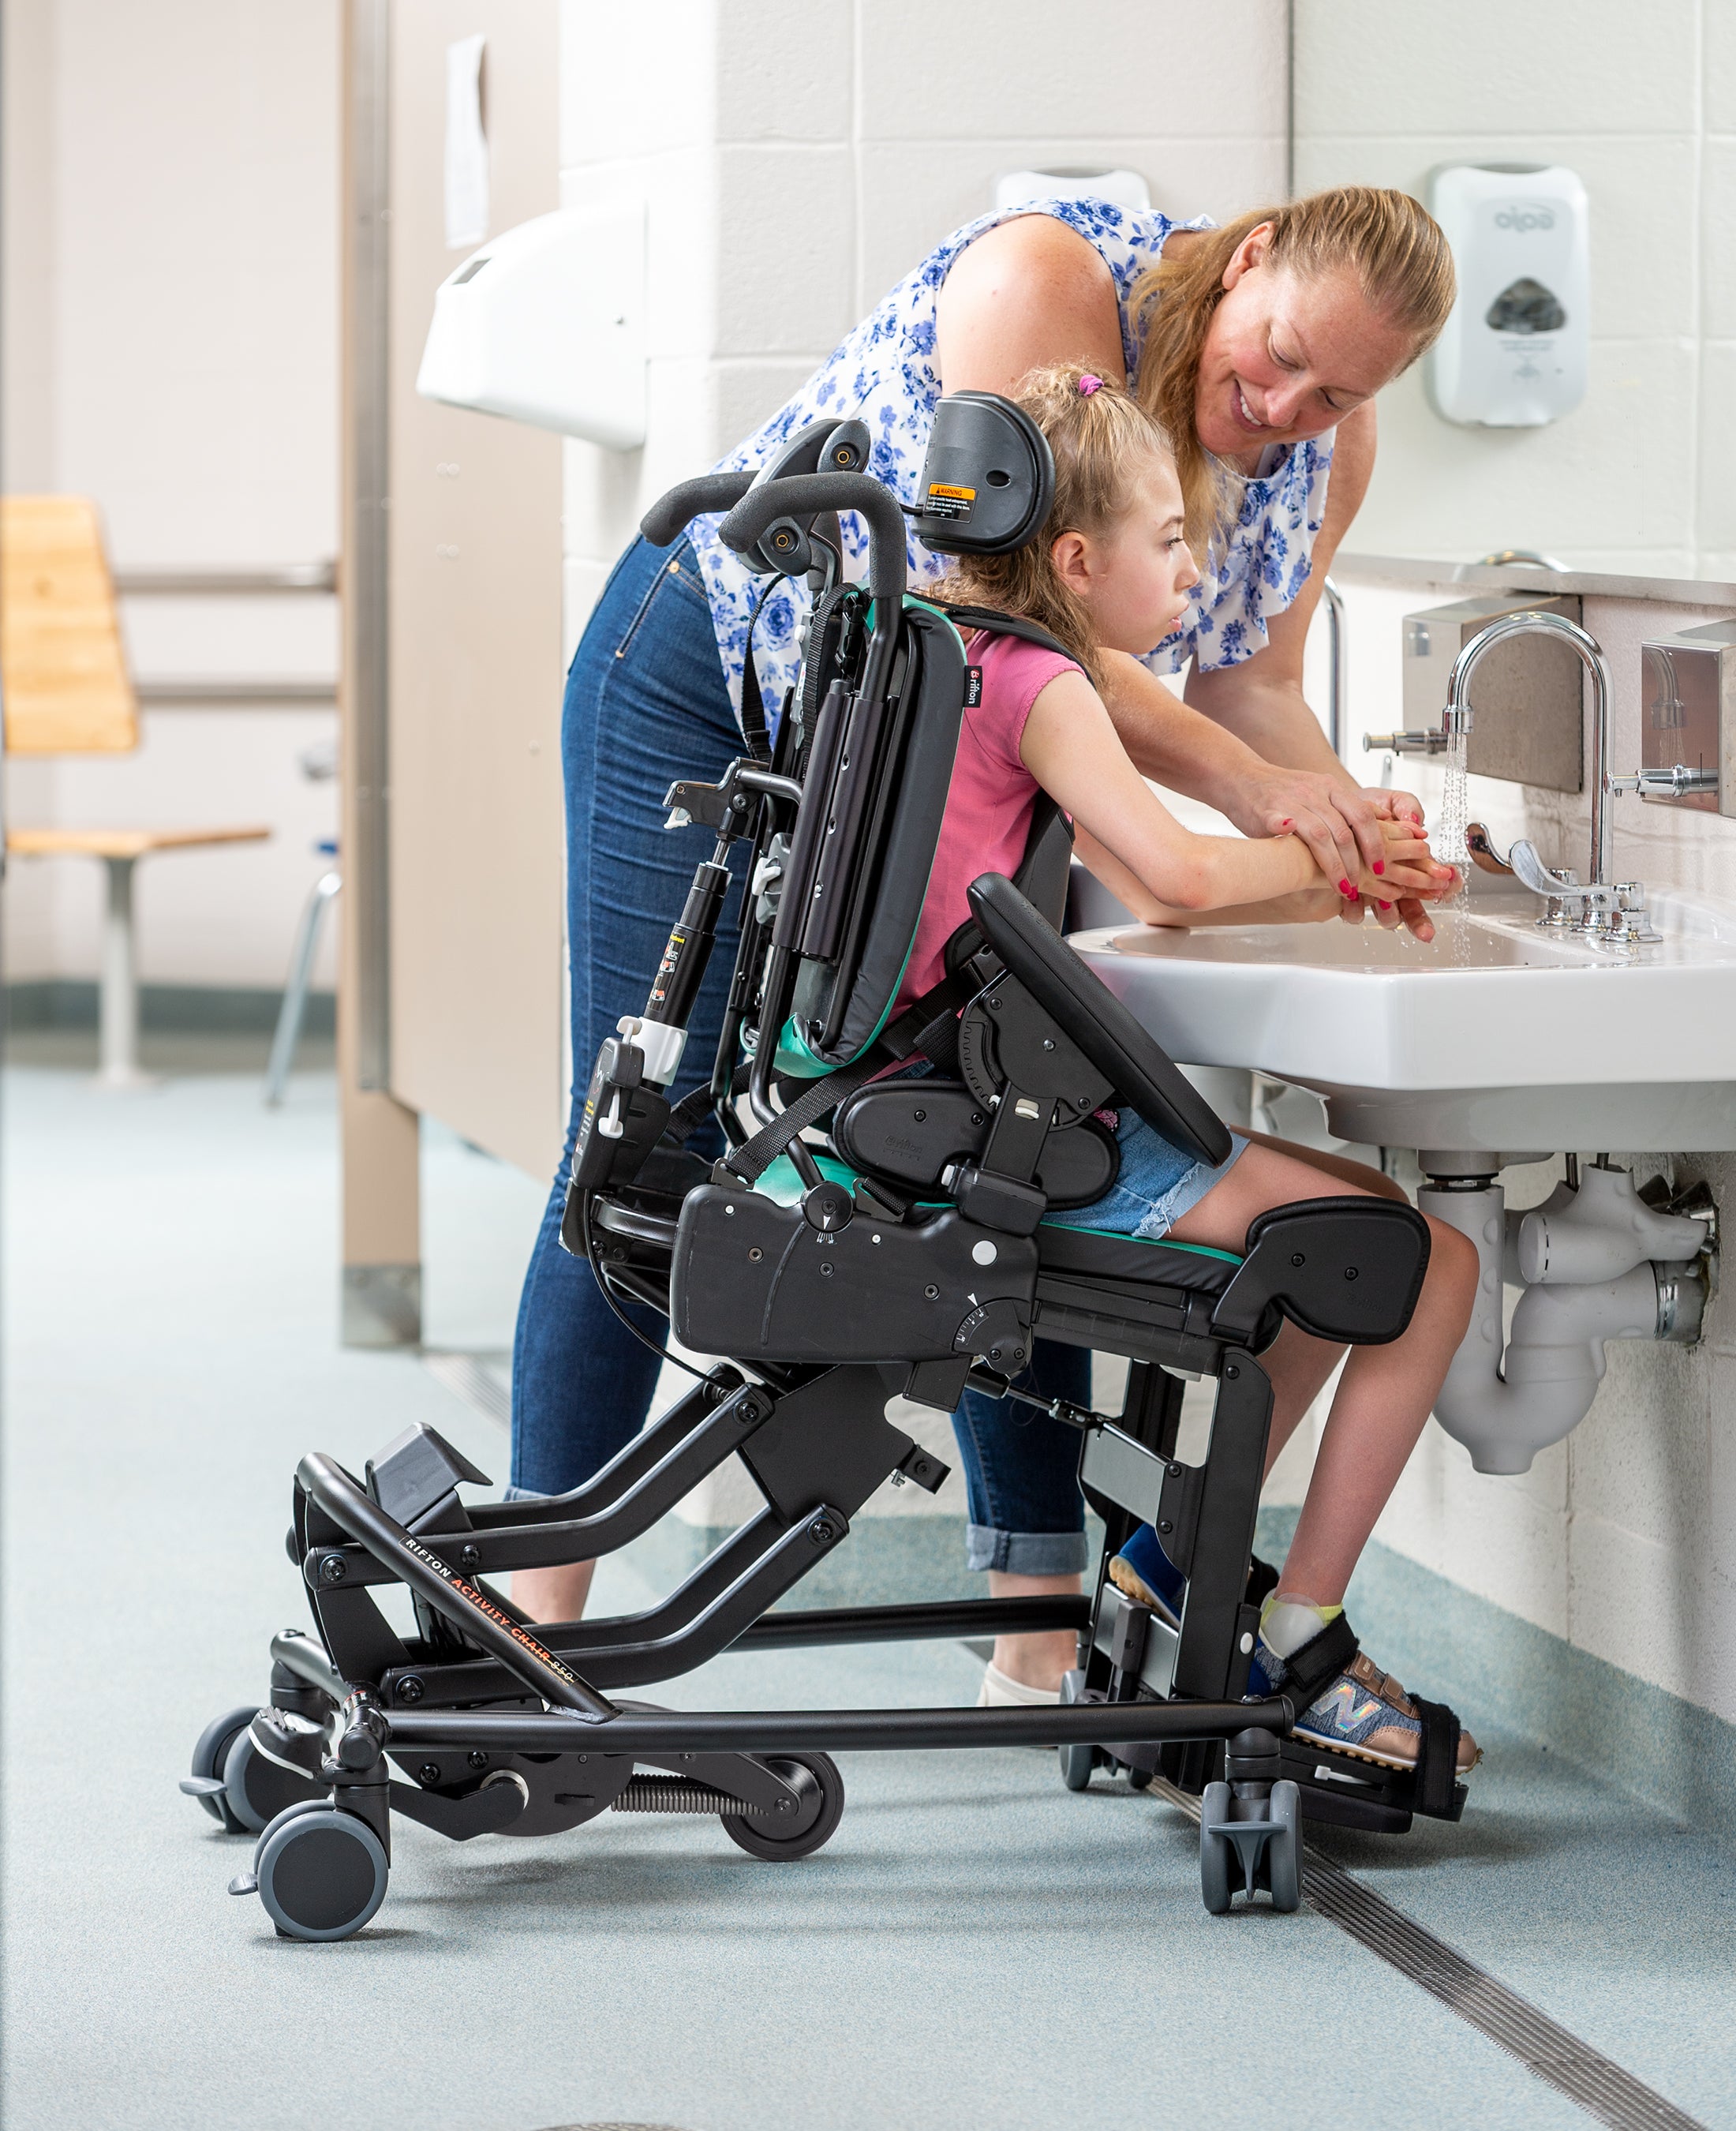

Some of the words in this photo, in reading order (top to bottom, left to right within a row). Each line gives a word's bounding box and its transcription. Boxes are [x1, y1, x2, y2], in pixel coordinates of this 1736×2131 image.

[968, 679, 980, 704] rifton
[406, 1538, 452, 1578] RIFTON
[451, 1579, 511, 1627] ACTIVITY
[511, 1627, 551, 1662] CHAIR
[551, 1661, 574, 1681] 850
[1309, 1682, 1382, 1734] N
